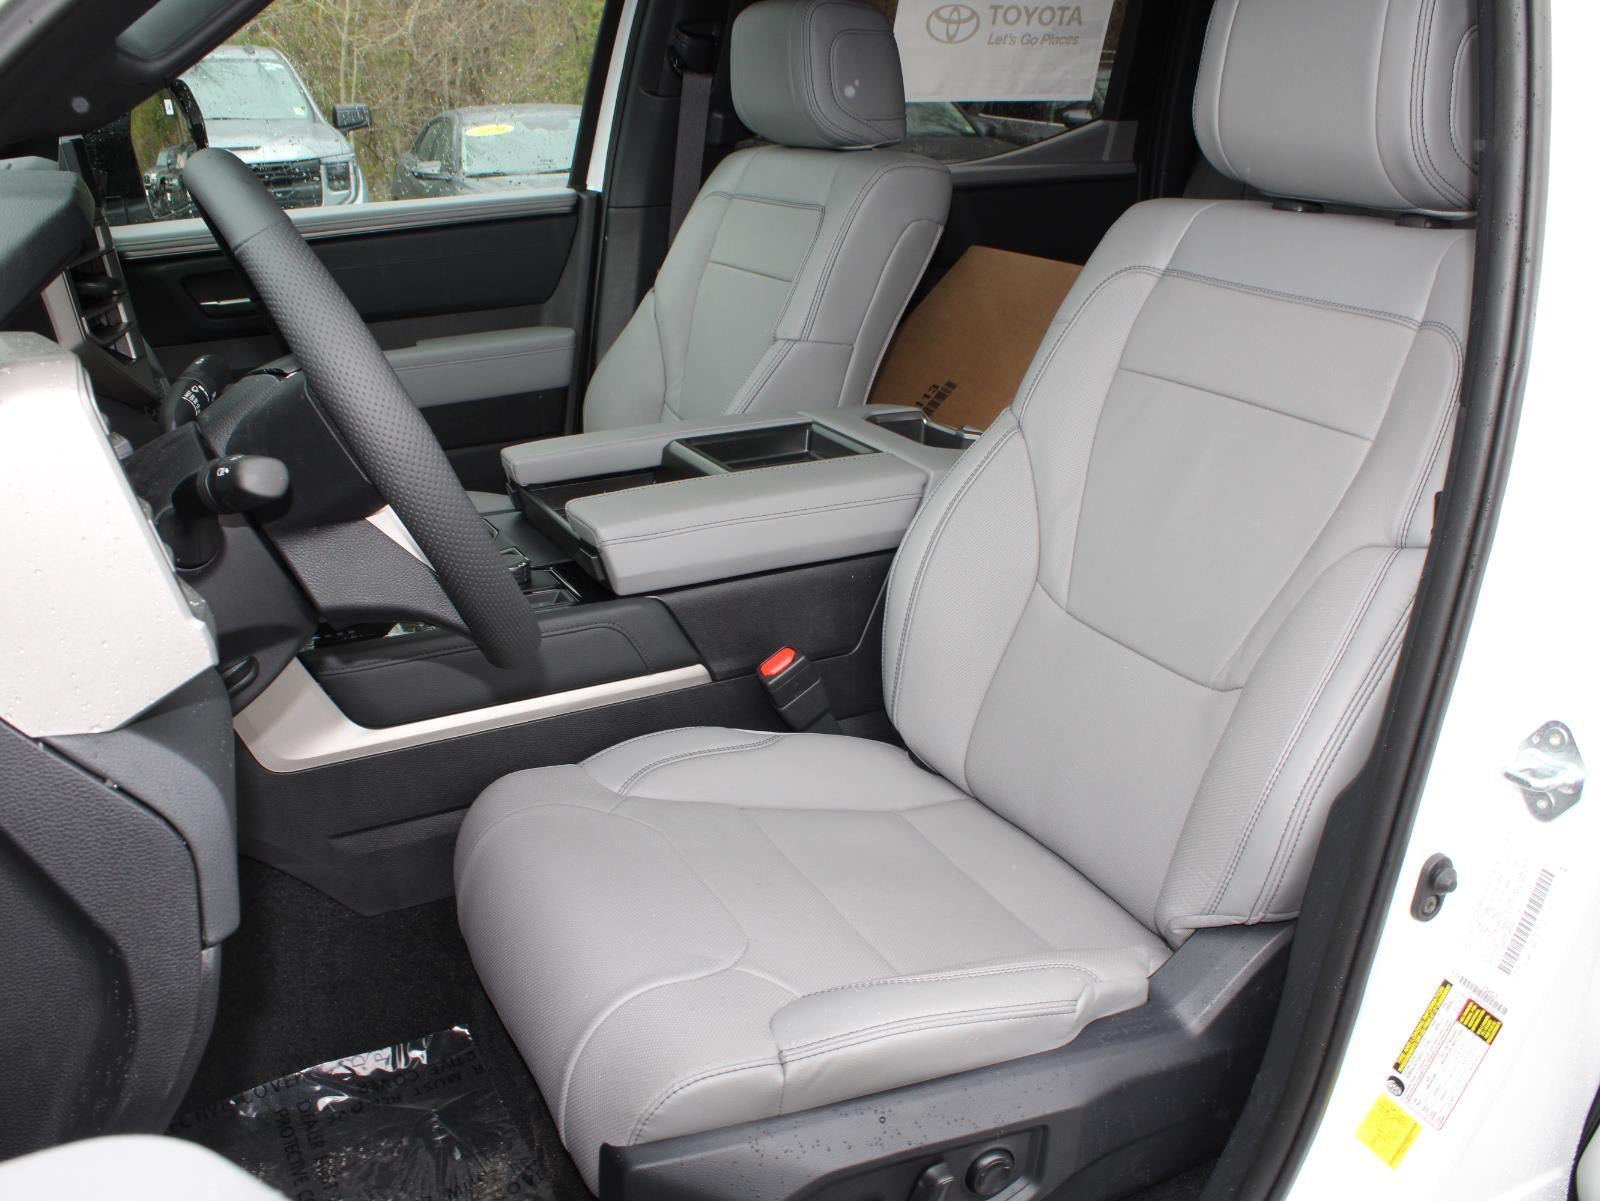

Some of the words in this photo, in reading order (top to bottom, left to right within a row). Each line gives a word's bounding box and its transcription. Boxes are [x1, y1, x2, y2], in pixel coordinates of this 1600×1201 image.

[989, 4, 1083, 27] TOYOTA
[986, 32, 1018, 47] Let's
[1020, 32, 1040, 46] Go
[1041, 32, 1080, 47] Places
